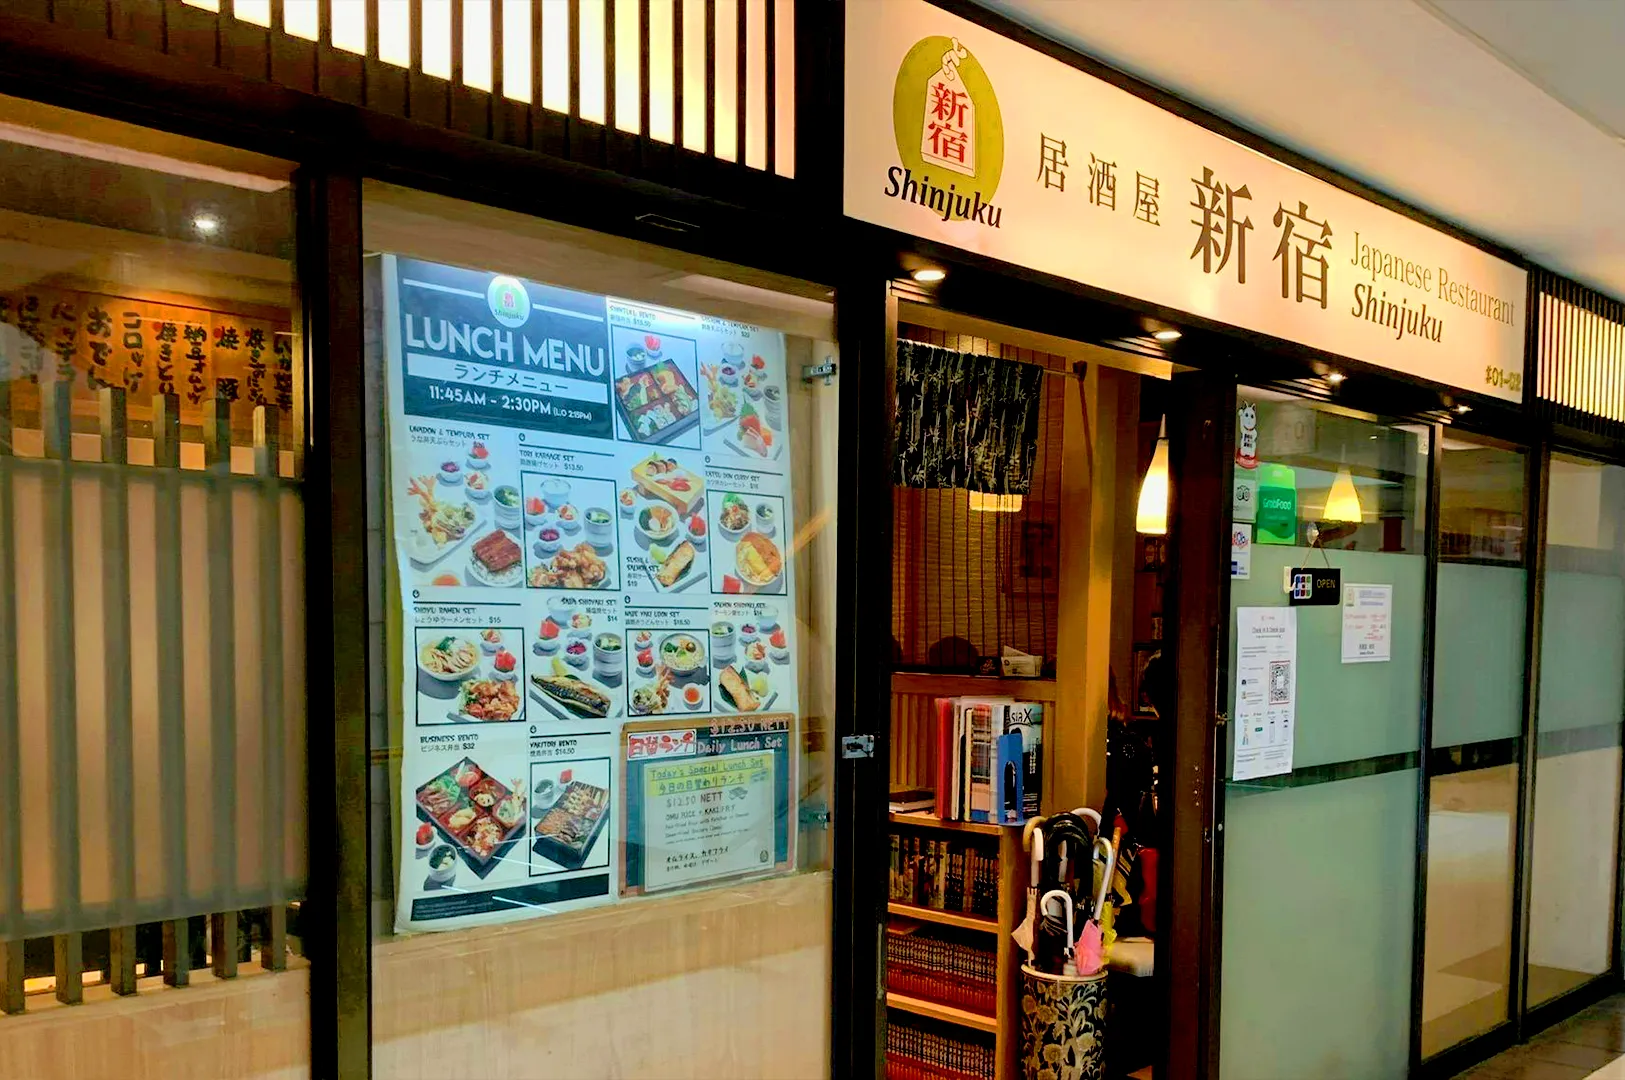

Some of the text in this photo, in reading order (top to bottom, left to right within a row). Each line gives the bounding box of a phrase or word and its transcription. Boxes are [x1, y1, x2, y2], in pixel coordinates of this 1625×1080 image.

[927, 82, 969, 163] 新宿
[884, 166, 1002, 228] Shinjuku
[1037, 132, 1333, 309] 居酒屋 新宿
[1351, 231, 1515, 327] Japanese Restaurant
[1351, 283, 1443, 343] Shinjuku
[405, 313, 605, 377] LUNCH MENU
[454, 363, 569, 393] ランチメニュー
[429, 385, 486, 407] 11:45AM
[502, 395, 552, 415] 2:30PM
[446, 429, 475, 440] TEMPURA
[1263, 498, 1292, 510] GrabFood
[1316, 579, 1336, 588] OPEN
[420, 733, 479, 743] BUSINESS BENTO
[462, 742, 476, 750] $32
[558, 739, 578, 747] BENTO
[697, 736, 783, 754] Daily Lunch Set
[651, 757, 764, 778] Today's Special Lunch Set
[700, 791, 722, 803] NETT
